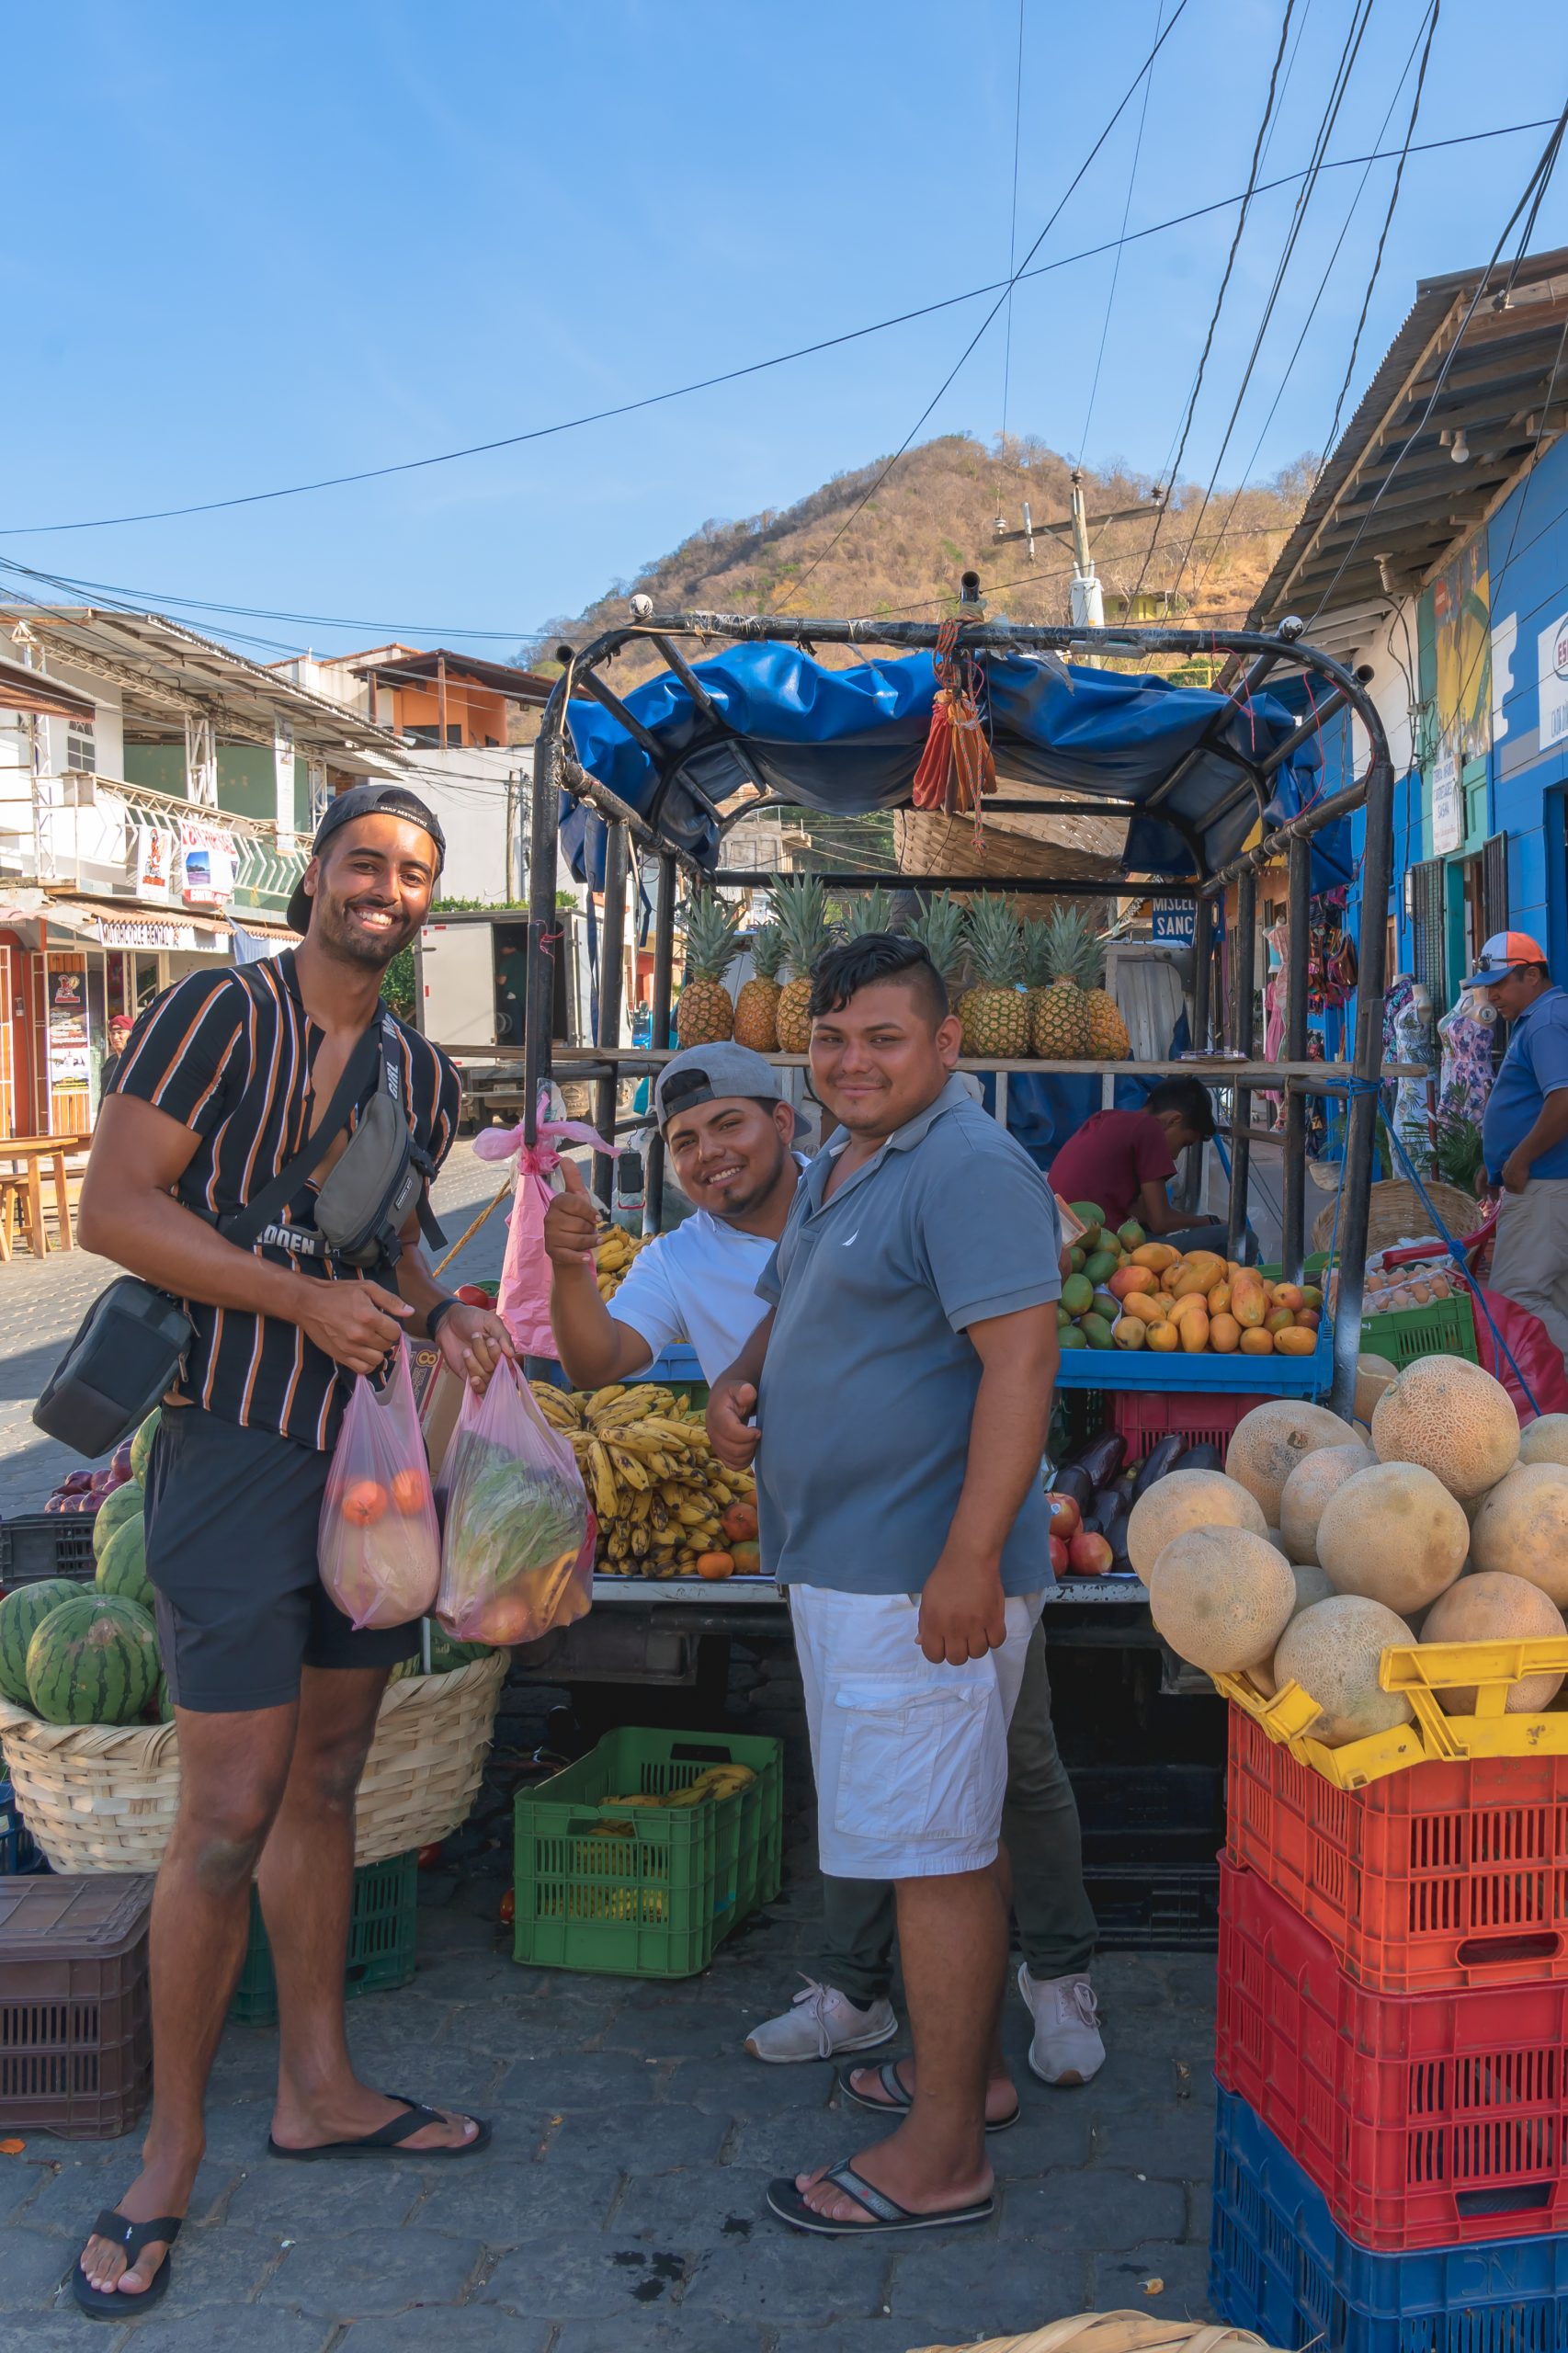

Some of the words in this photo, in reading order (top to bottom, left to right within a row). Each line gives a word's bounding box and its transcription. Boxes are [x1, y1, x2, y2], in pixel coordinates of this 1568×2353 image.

[1558, 638, 1568, 665] ES
[146, 925, 169, 947] RENTAL
[1156, 915, 1194, 936] SANC
[386, 1061, 399, 1100] GIRL
